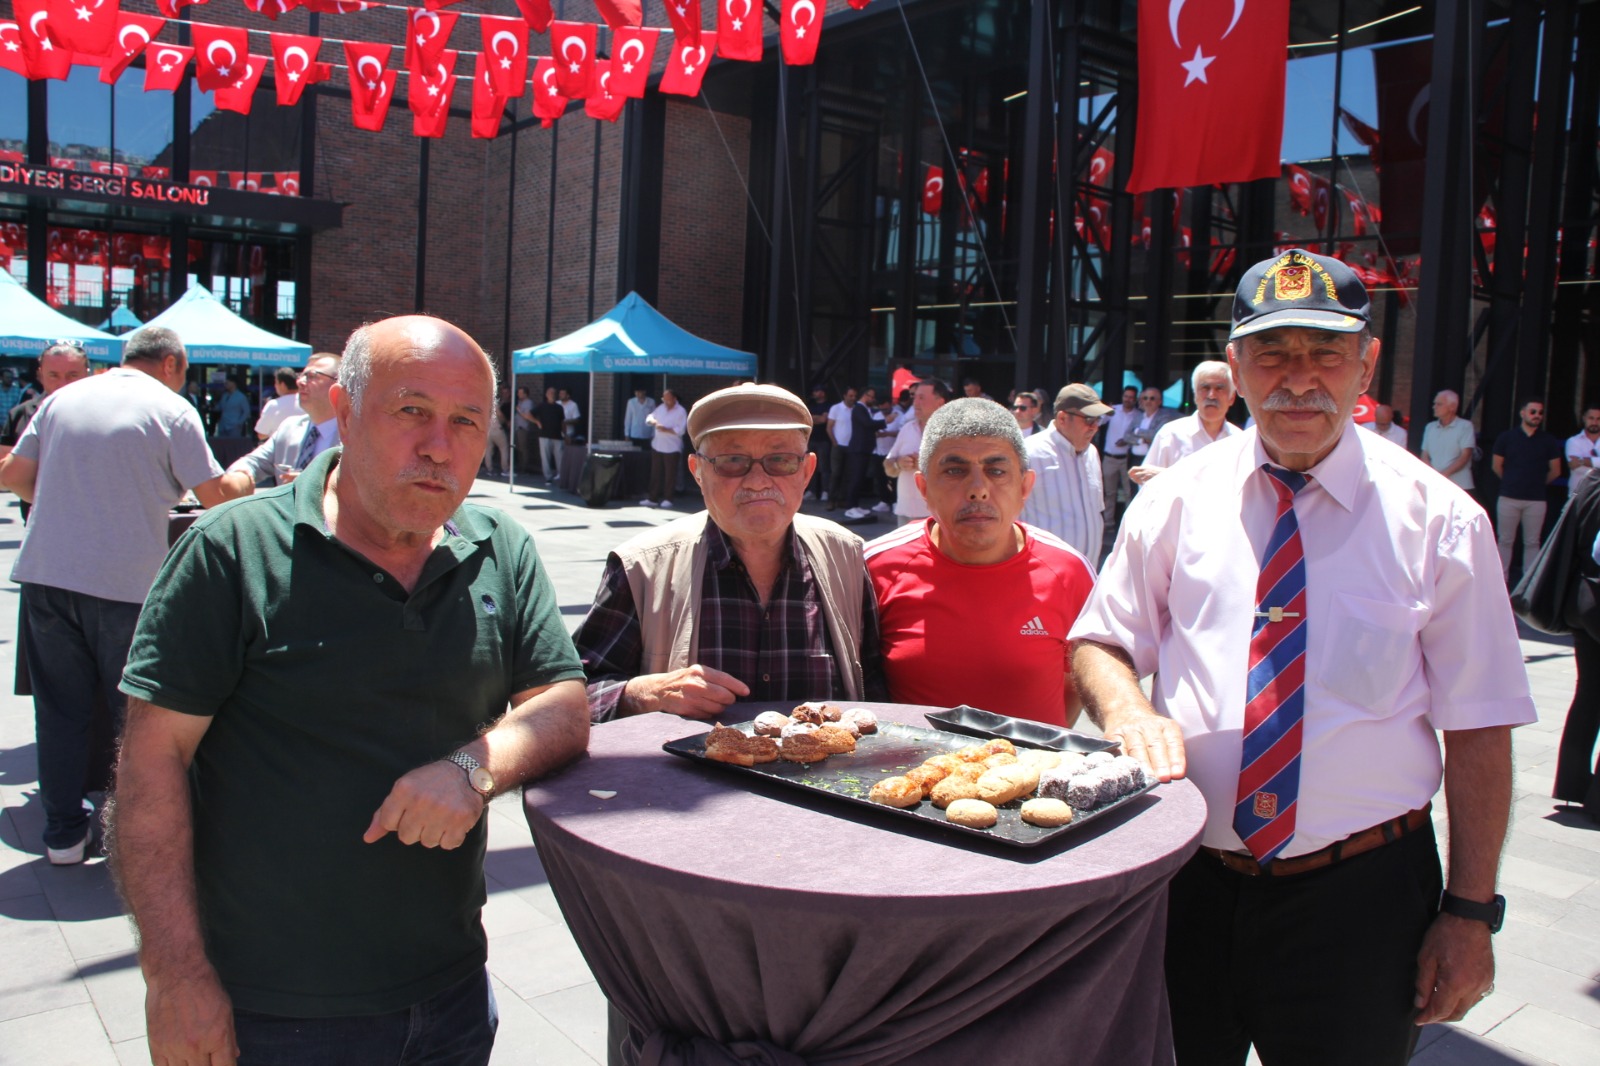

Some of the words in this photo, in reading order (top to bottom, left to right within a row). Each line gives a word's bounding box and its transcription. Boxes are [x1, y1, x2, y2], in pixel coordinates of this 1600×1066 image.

[70, 174, 126, 196] SERGİ
[131, 181, 209, 205] SALONU
[614, 356, 650, 367] KOCAELİ
[652, 355, 704, 370] BÜYÜKŞEHİR
[705, 358, 750, 371] BELEDİYESİ
